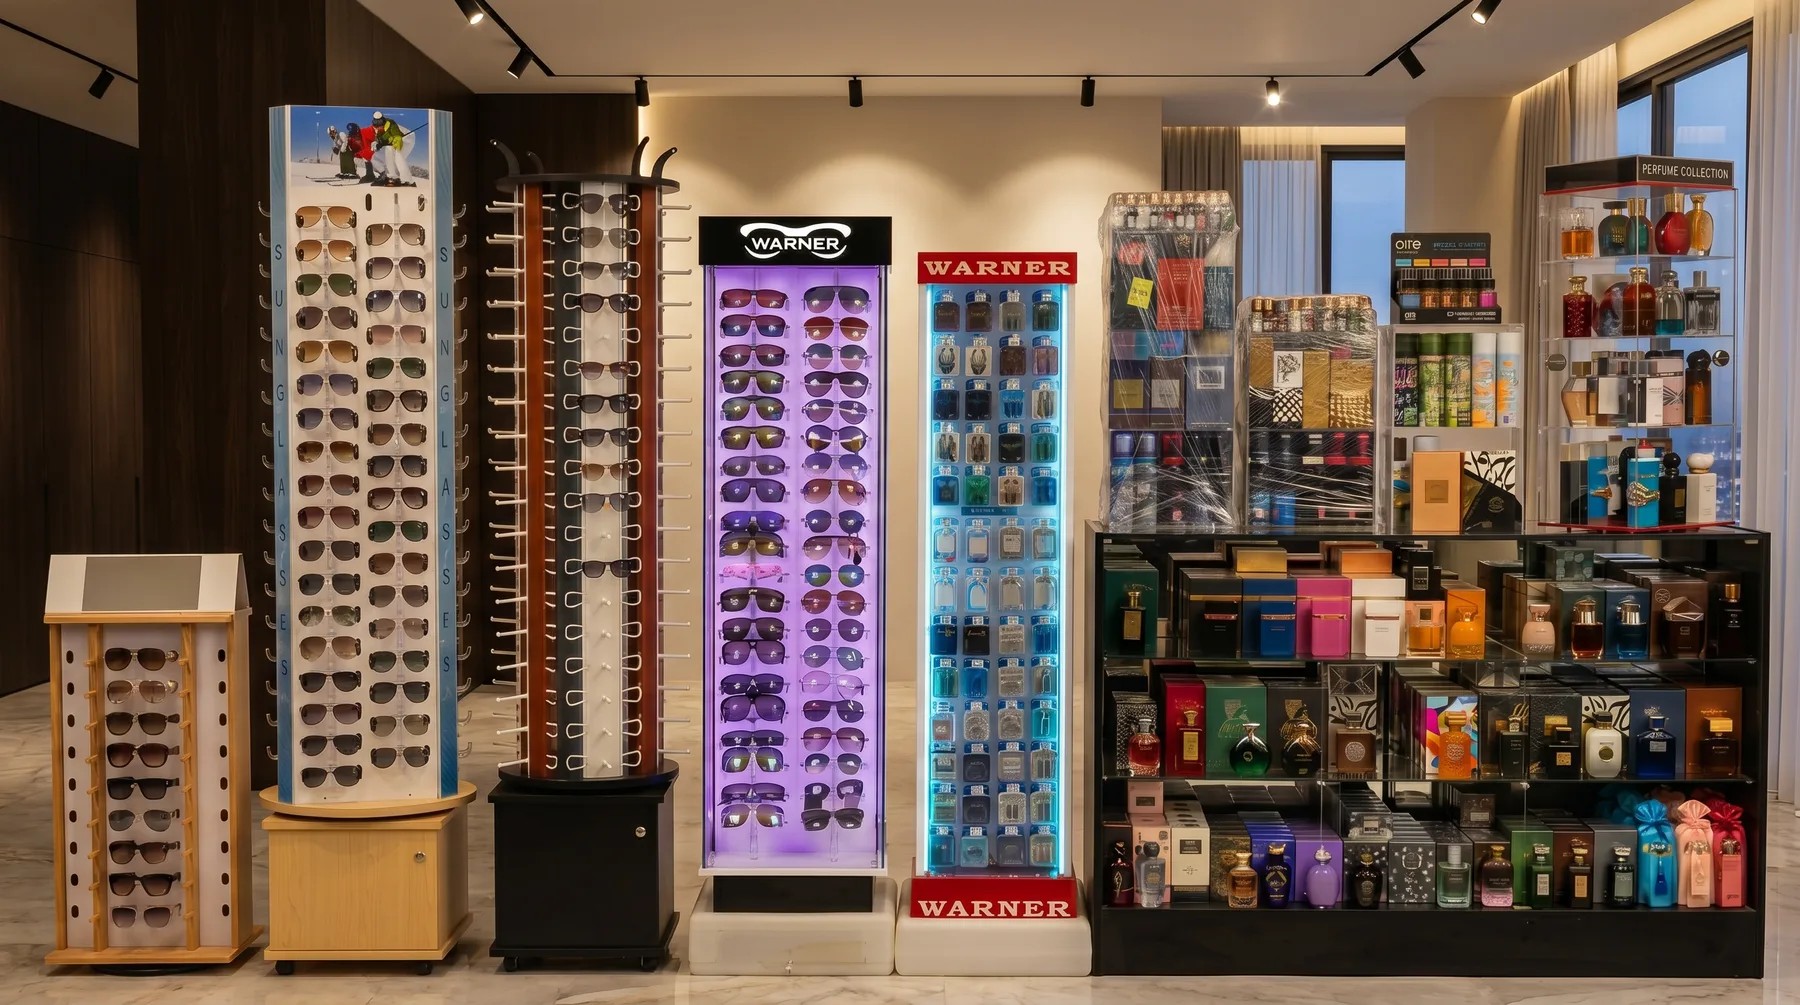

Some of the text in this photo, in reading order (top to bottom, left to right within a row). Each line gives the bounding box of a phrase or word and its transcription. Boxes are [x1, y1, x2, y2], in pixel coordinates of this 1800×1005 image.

[1642, 163, 1729, 179] PERFUME COLLECTION
[751, 237, 840, 250] WARNER
[923, 261, 1071, 276] WARNER
[274, 243, 288, 676] SUNGLASSES
[440, 246, 450, 673] SUNGLASSES
[917, 900, 1071, 917] WARNER
